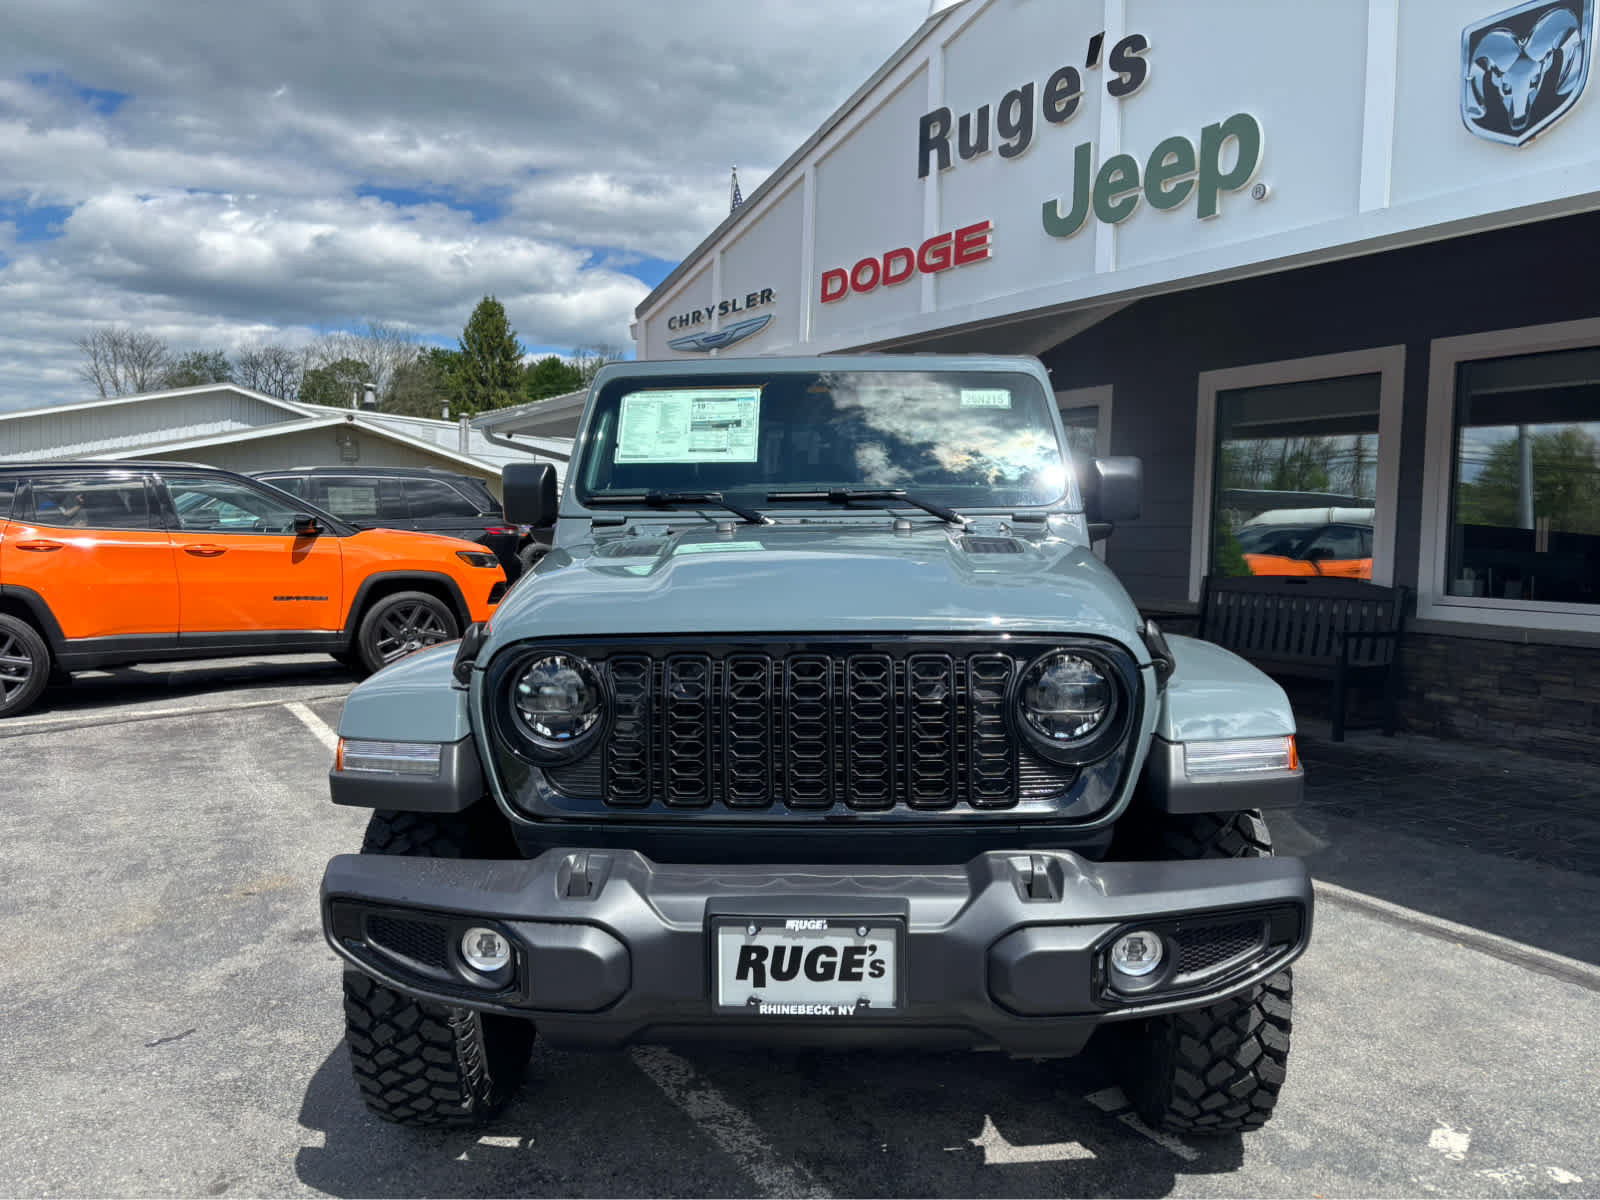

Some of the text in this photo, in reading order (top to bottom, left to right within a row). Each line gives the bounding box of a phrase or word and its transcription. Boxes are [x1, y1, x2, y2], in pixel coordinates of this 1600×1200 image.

[918, 31, 1149, 178] Ruge's
[820, 220, 992, 303] DODGE
[667, 287, 774, 330] CHRYSLER
[838, 1006, 856, 1016] NY
